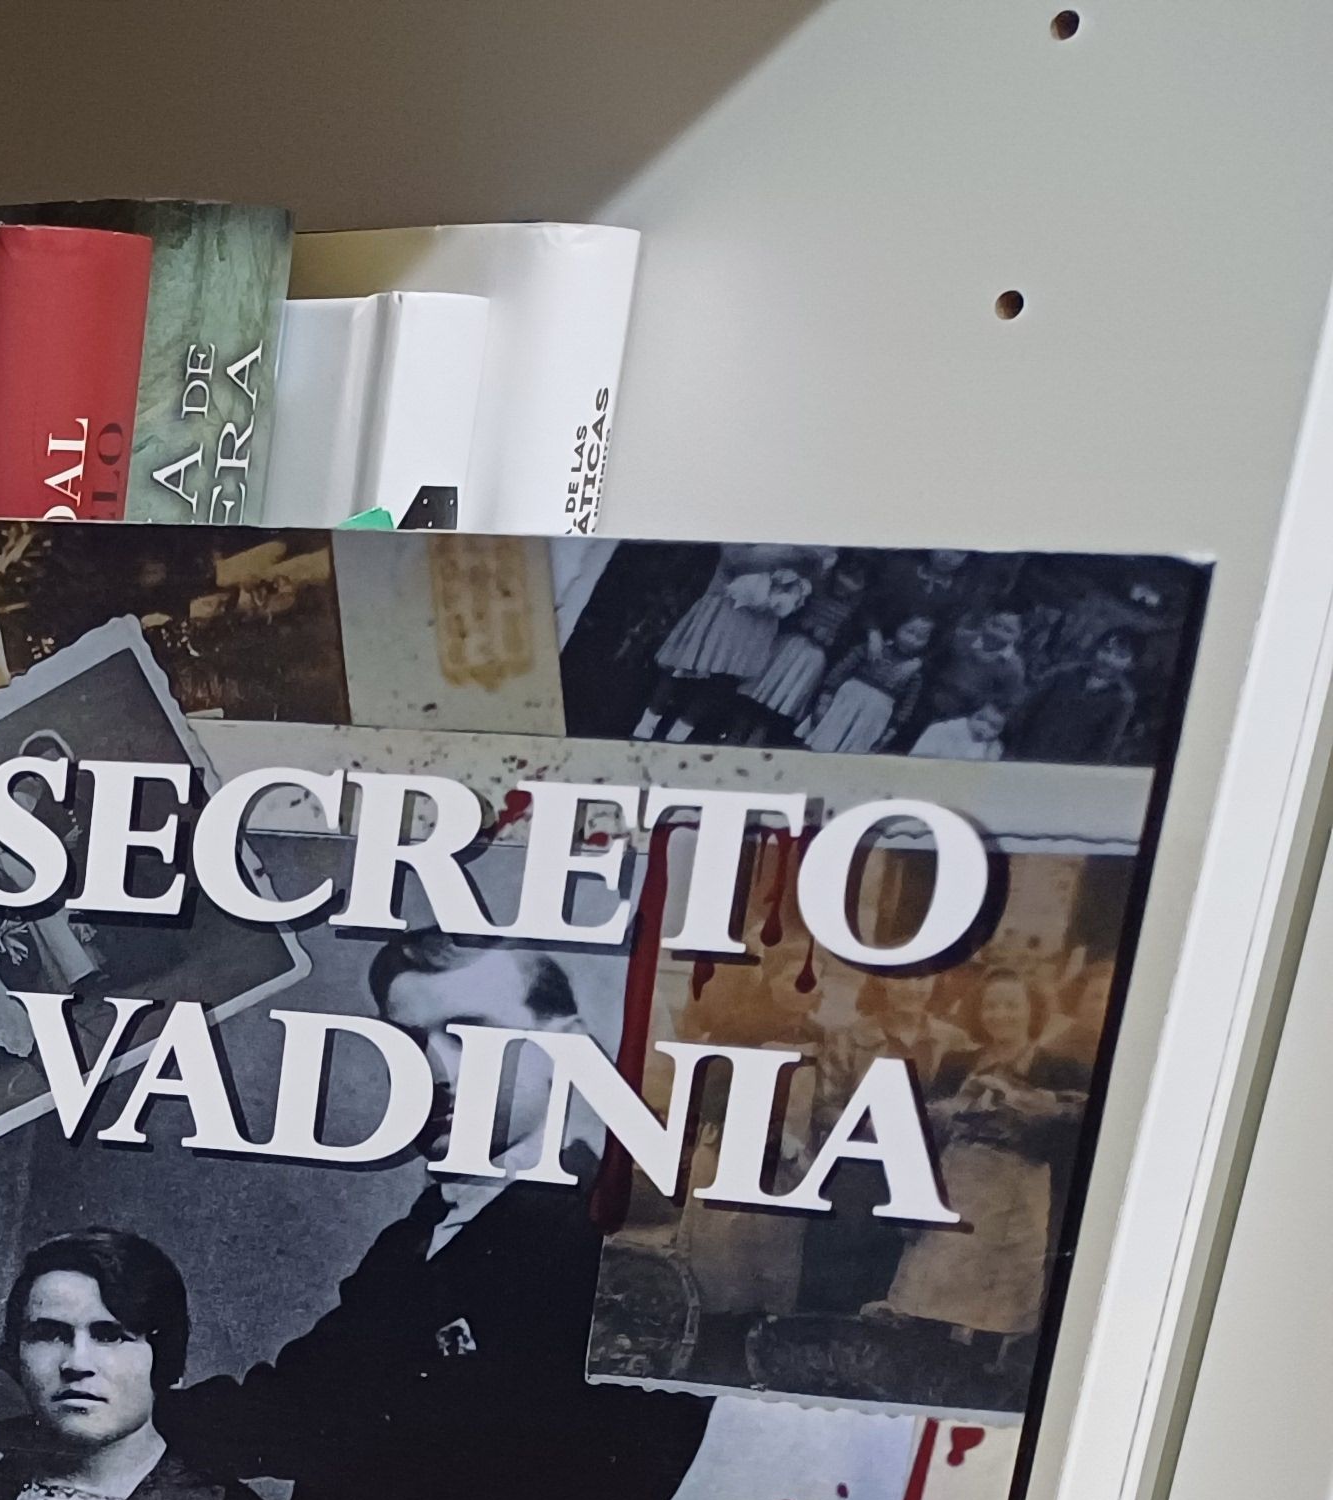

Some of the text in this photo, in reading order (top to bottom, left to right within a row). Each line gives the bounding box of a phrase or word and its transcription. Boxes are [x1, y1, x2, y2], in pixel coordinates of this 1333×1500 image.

[181, 343, 216, 418] DE
[565, 425, 588, 514] DE LAS
[6, 990, 961, 1224] VADINIA
